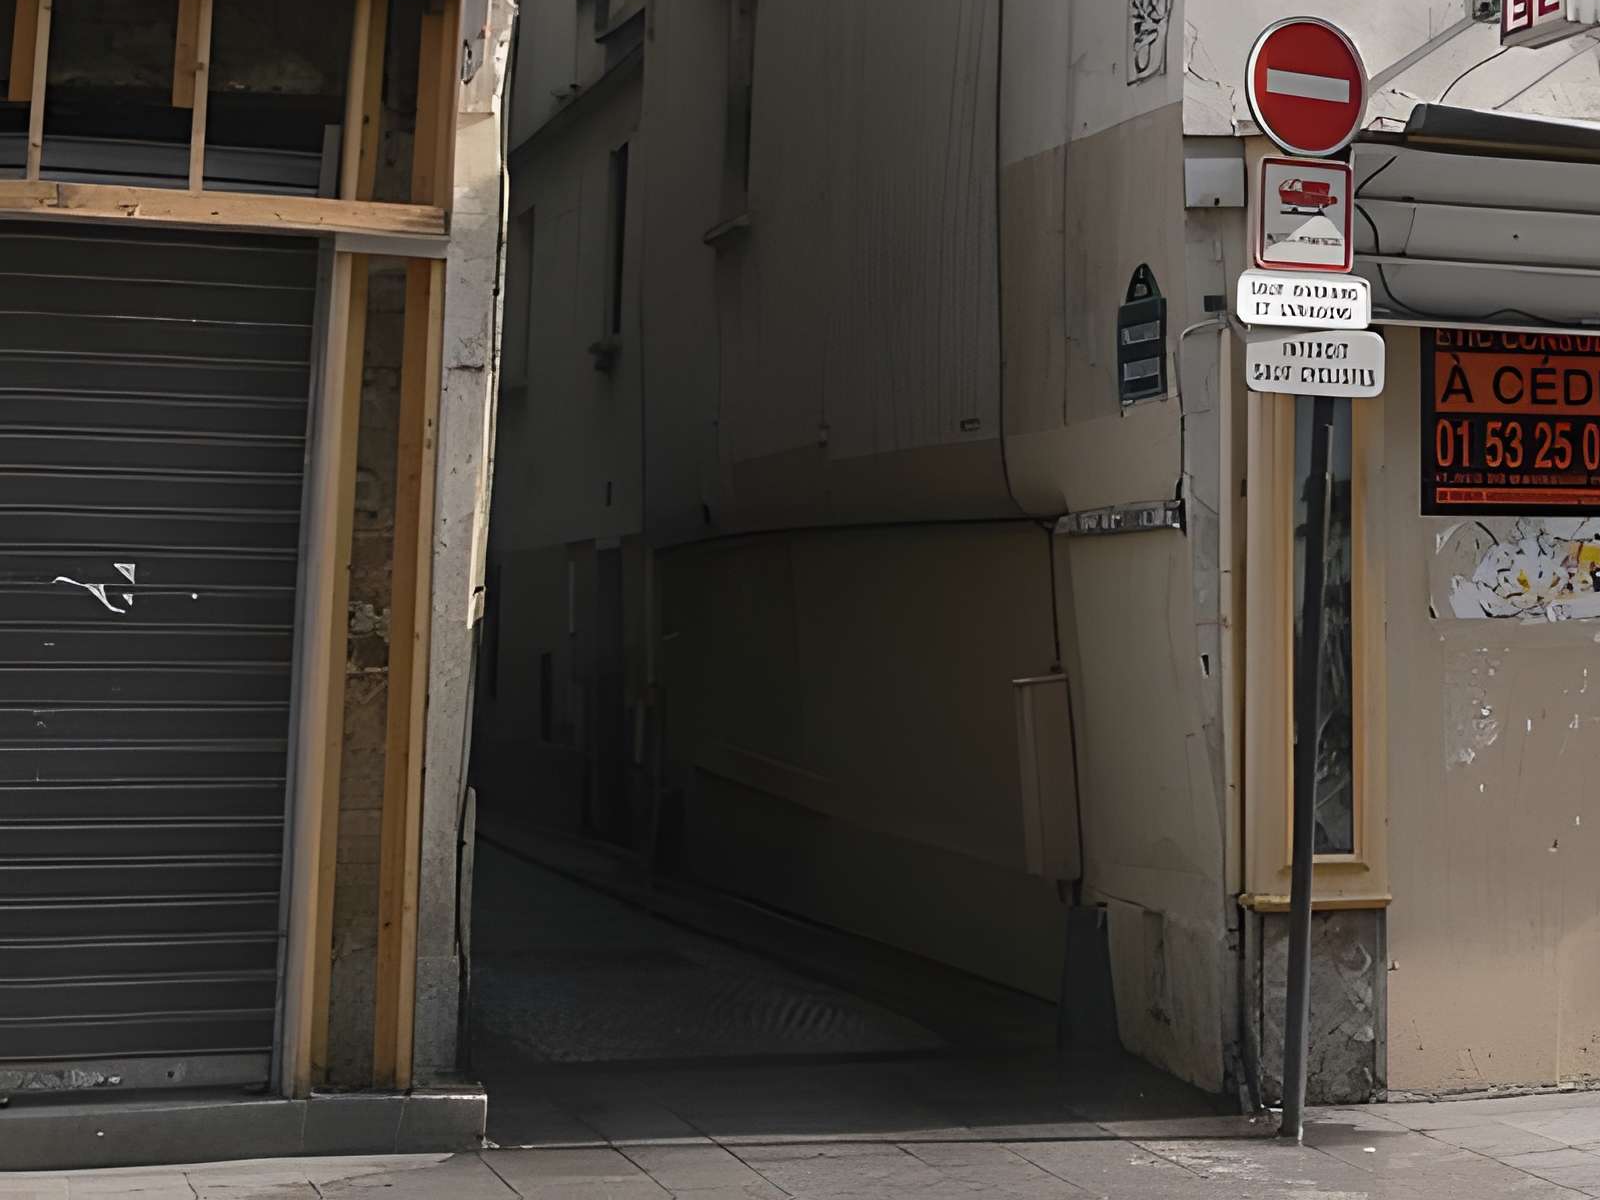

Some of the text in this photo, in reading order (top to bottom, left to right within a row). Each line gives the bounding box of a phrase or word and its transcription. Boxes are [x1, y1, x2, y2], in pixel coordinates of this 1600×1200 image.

[1441, 351, 1474, 404] À
[1436, 418, 1470, 467] 01
[1485, 419, 1524, 468] 53
[1534, 420, 1574, 469] 25
